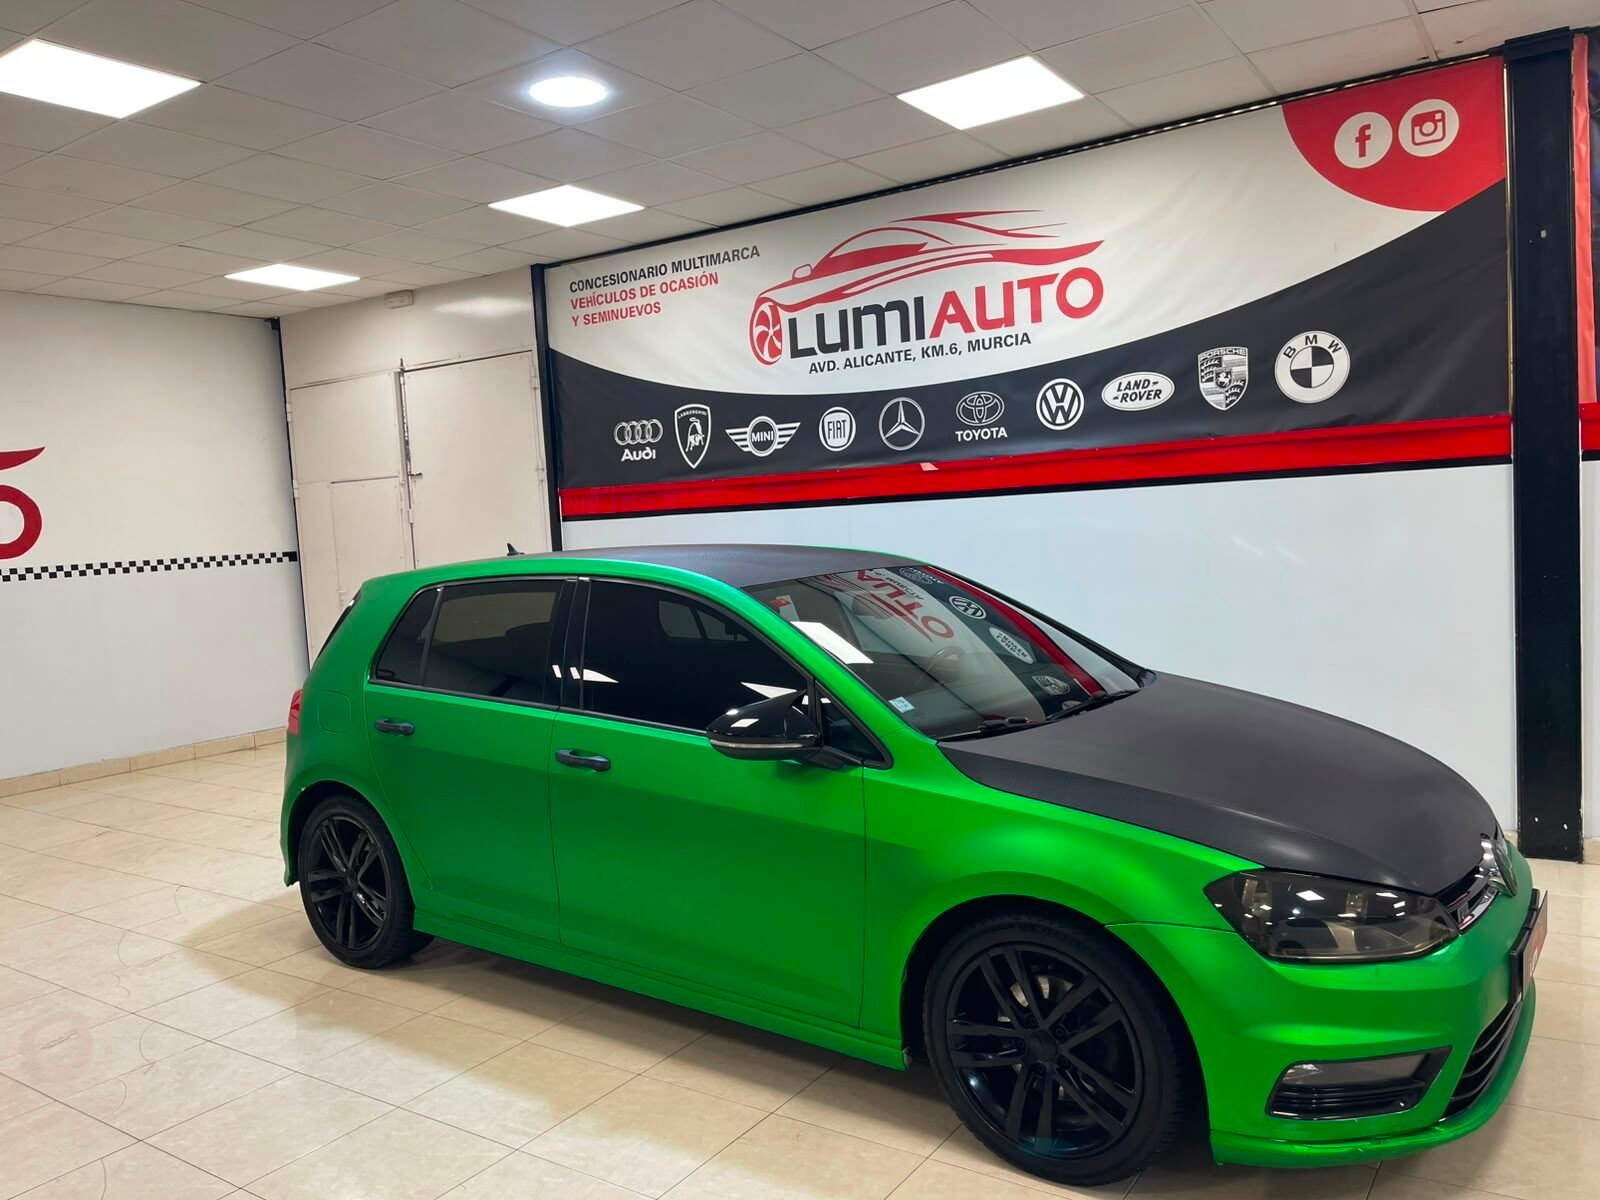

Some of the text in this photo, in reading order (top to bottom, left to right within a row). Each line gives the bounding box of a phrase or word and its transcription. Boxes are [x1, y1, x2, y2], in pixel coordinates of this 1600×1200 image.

[569, 245, 760, 293] CONCESIONARIO MULTIMARCA
[570, 271, 719, 310] VEHÍCULOS DE OCASIÓN
[571, 301, 662, 327] Y SEMINUEVOS
[808, 332, 1032, 375] AVD. ALICANTE, KM.6, MURCIA
[751, 430, 774, 443] MINI
[827, 418, 848, 441] FIAT
[955, 426, 1008, 442] TOYOTA
[620, 446, 656, 462] Audi
